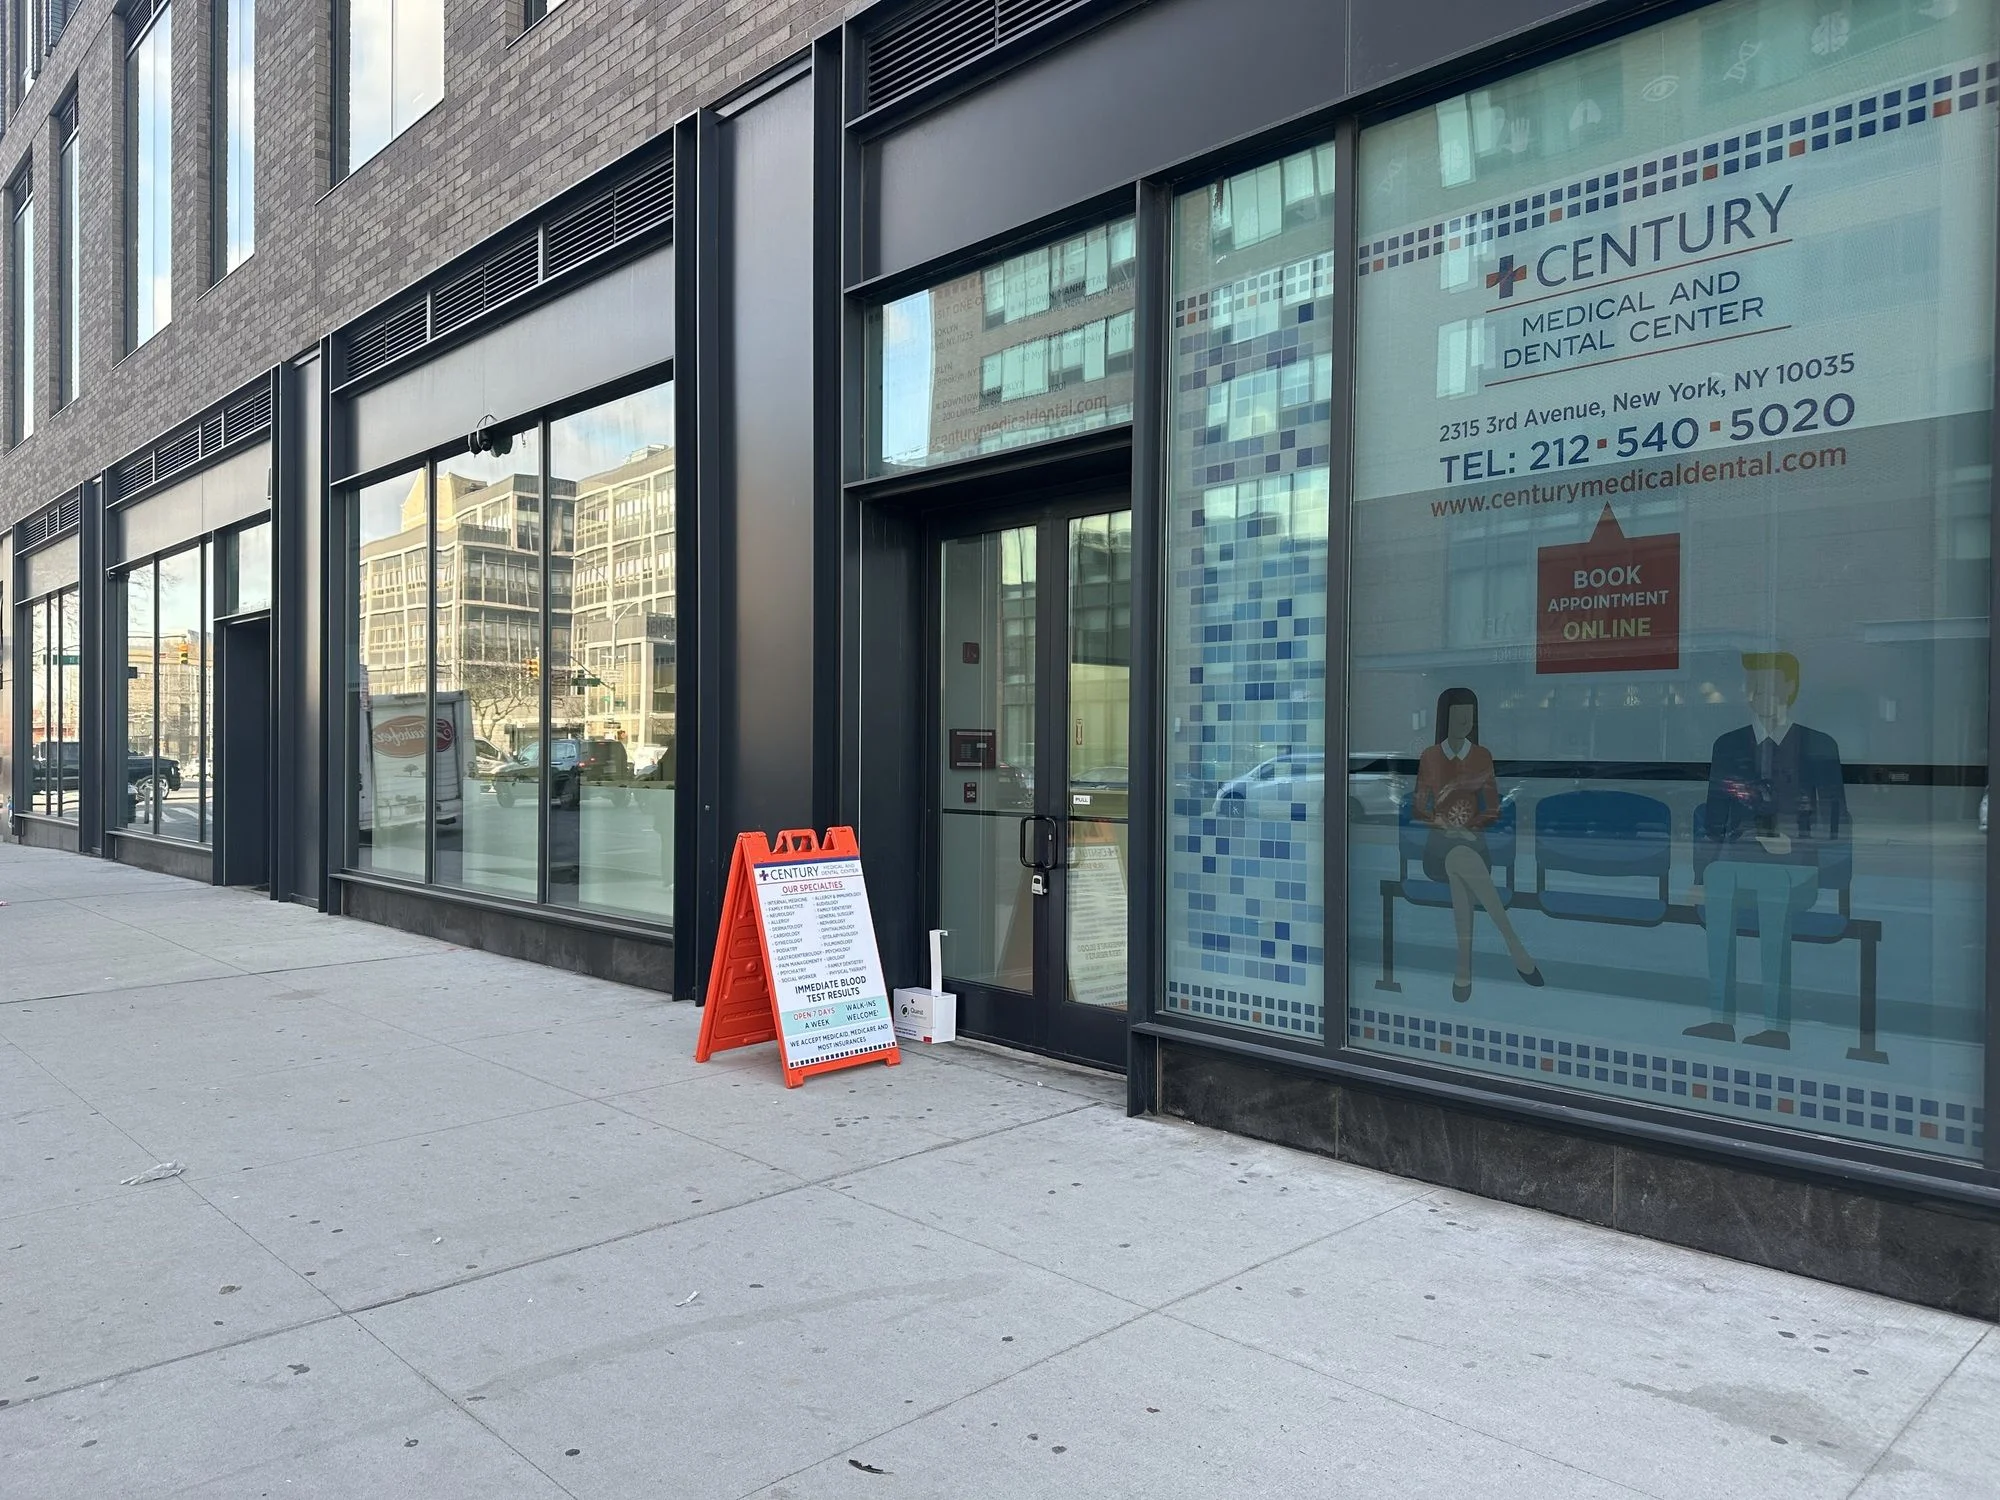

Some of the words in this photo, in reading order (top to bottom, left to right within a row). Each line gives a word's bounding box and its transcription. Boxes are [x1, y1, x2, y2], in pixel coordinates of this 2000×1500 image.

[1536, 184, 1794, 287] CENTURY
[1523, 291, 1655, 337] MEDICAL
[1669, 270, 1740, 305] AND
[1504, 330, 1615, 369] DENTAL
[1630, 296, 1764, 343] CENTER
[1439, 420, 1480, 442] 2315
[1487, 413, 1518, 434] 3rd
[1524, 400, 1606, 429] Avenue,
[1613, 386, 1661, 412] New
[1669, 373, 1726, 403] York,
[1734, 367, 1769, 392] NY
[1777, 352, 1855, 384] 10035
[1440, 449, 1516, 484] TEL:
[1430, 444, 1847, 518] www.centurymedicaldental.com
[1574, 565, 1642, 589] BOOK
[1548, 590, 1669, 612] APPOINTMENT
[1563, 617, 1651, 640] ONLINE
[770, 866, 819, 881] CENTURY
[782, 885, 798, 894] OUR
[799, 881, 843, 892] SPECIALTIES
[795, 979, 839, 994] IMMEDIATE
[840, 975, 867, 987] BLOOD
[807, 992, 826, 1003] TEST
[828, 987, 860, 1000] RESULTS
[793, 1011, 812, 1021] OPEN
[818, 1007, 836, 1017] DAYS
[845, 1000, 876, 1011] WALK-INS
[805, 1022, 810, 1030] A
[811, 1019, 830, 1028] WEEK
[790, 1039, 800, 1047] WE
[801, 1036, 822, 1045] ACCEPT
[822, 1031, 849, 1042] MEDICAID,
[850, 1026, 877, 1036] MEDICARE
[817, 1043, 833, 1051] MOST
[833, 1036, 867, 1048] INSURANCES
